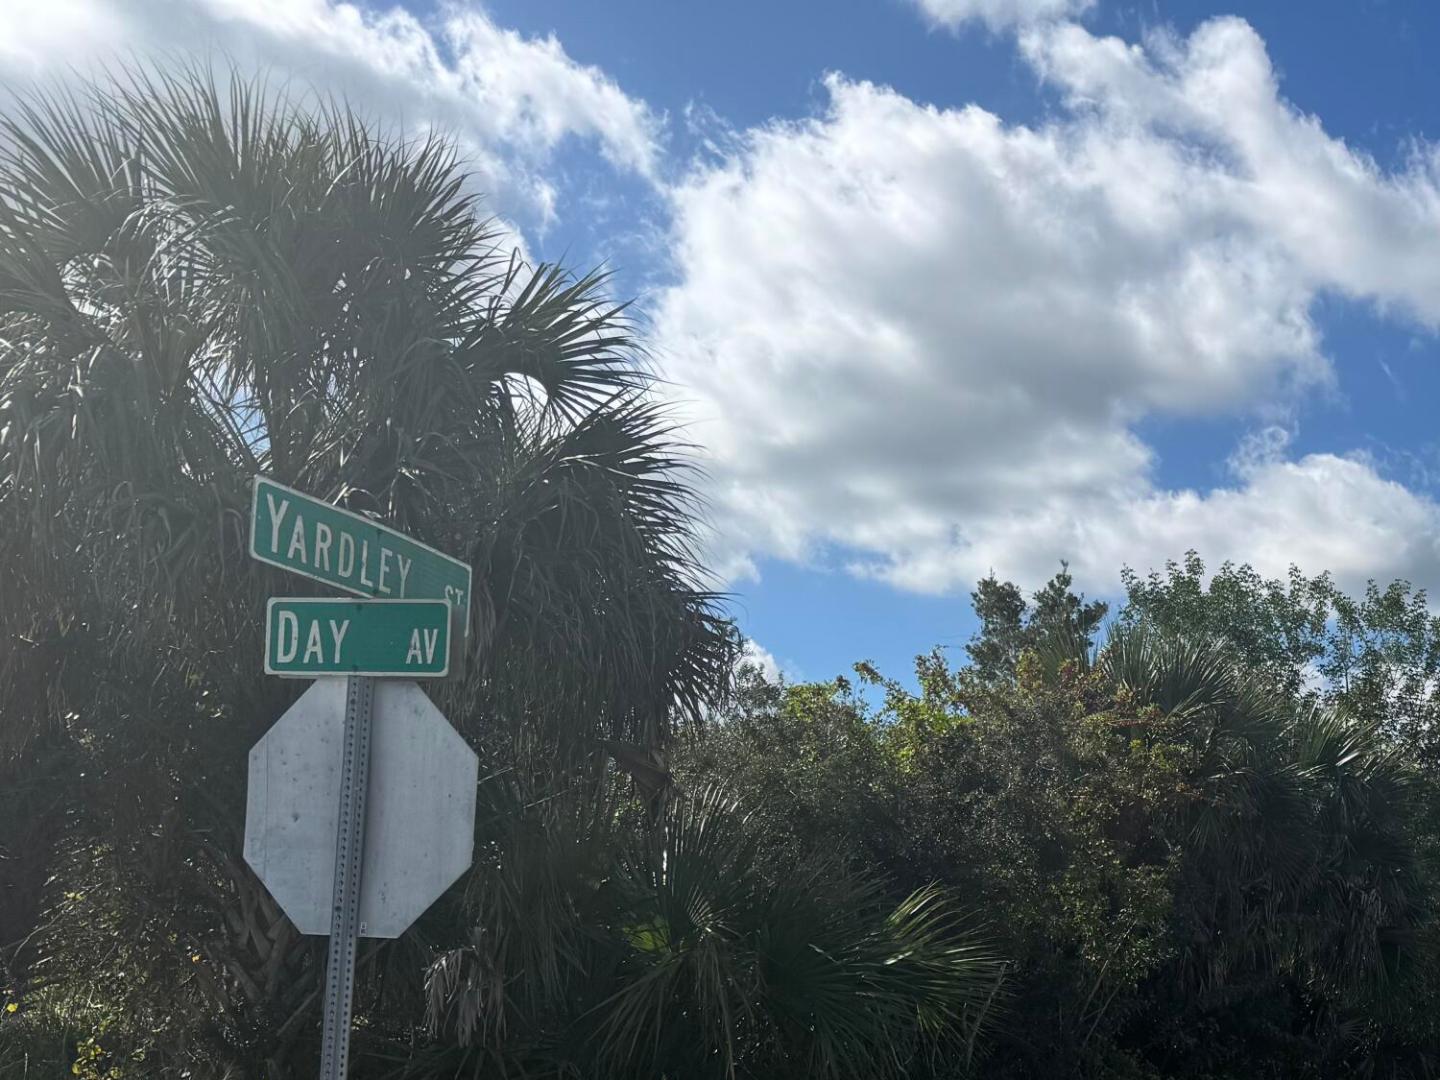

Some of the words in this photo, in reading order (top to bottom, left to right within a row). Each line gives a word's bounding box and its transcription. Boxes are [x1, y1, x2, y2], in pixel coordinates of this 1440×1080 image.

[267, 493, 412, 599] YARDLEY
[276, 610, 350, 664] DAY
[405, 628, 439, 665] AV
